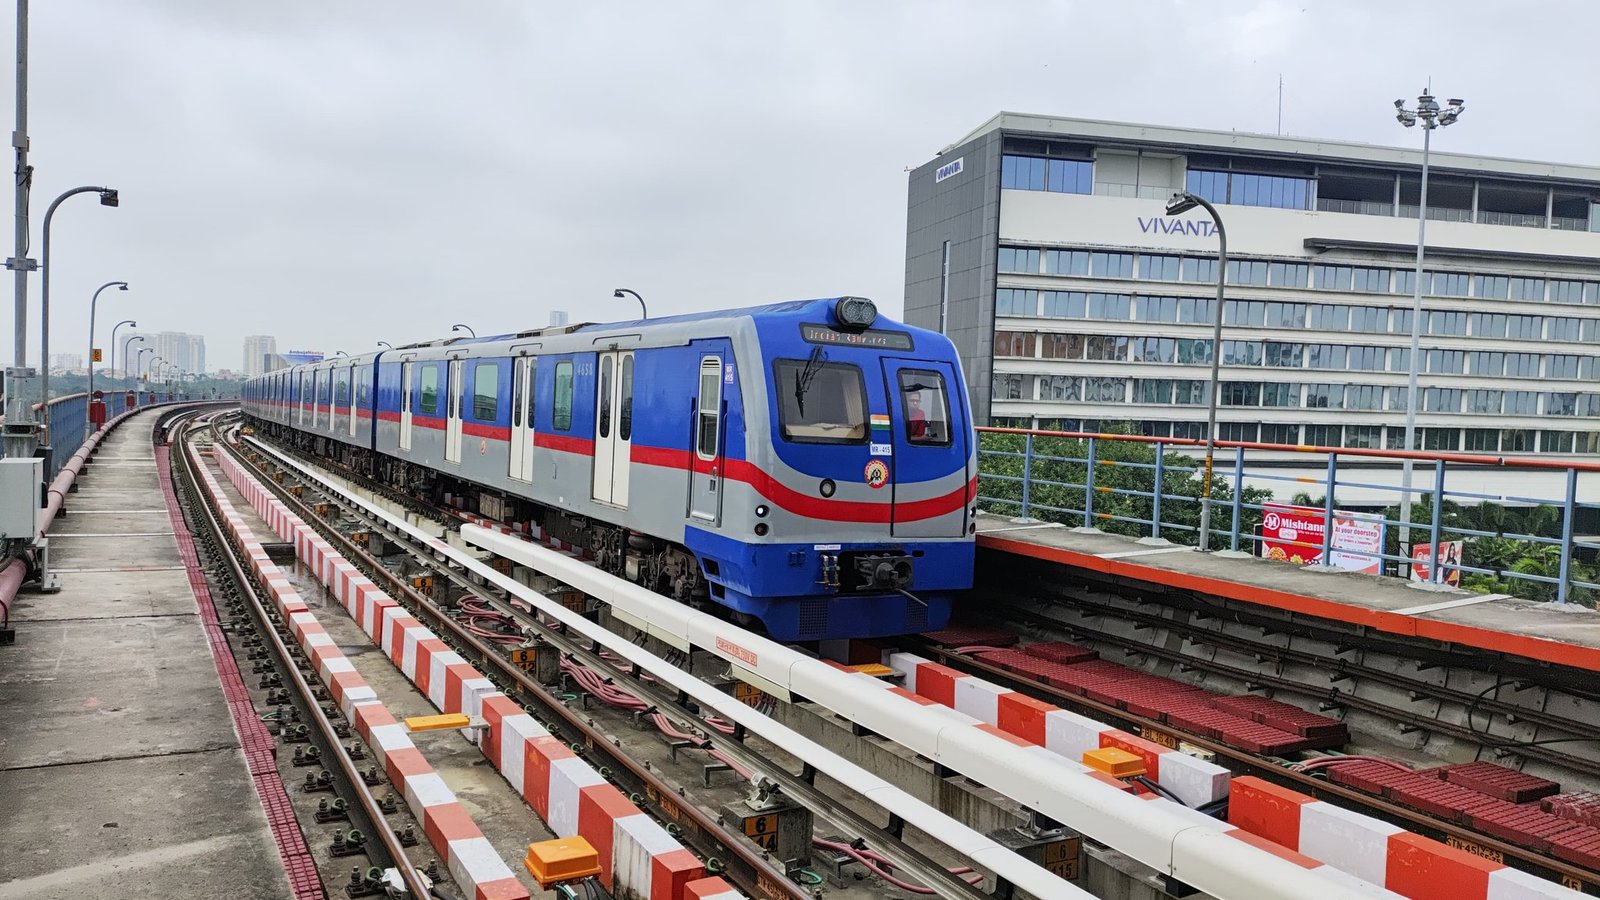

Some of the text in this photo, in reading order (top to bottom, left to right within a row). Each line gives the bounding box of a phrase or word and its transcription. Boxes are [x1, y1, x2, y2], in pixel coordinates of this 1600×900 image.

[1138, 217, 1219, 237] VIVANTA
[1354, 529, 1378, 538] doorstep
[521, 651, 527, 661] 6
[746, 685, 752, 694] 6
[755, 816, 766, 833] 6
[1060, 844, 1066, 859] 6
[1446, 837, 1477, 855] STN-45
